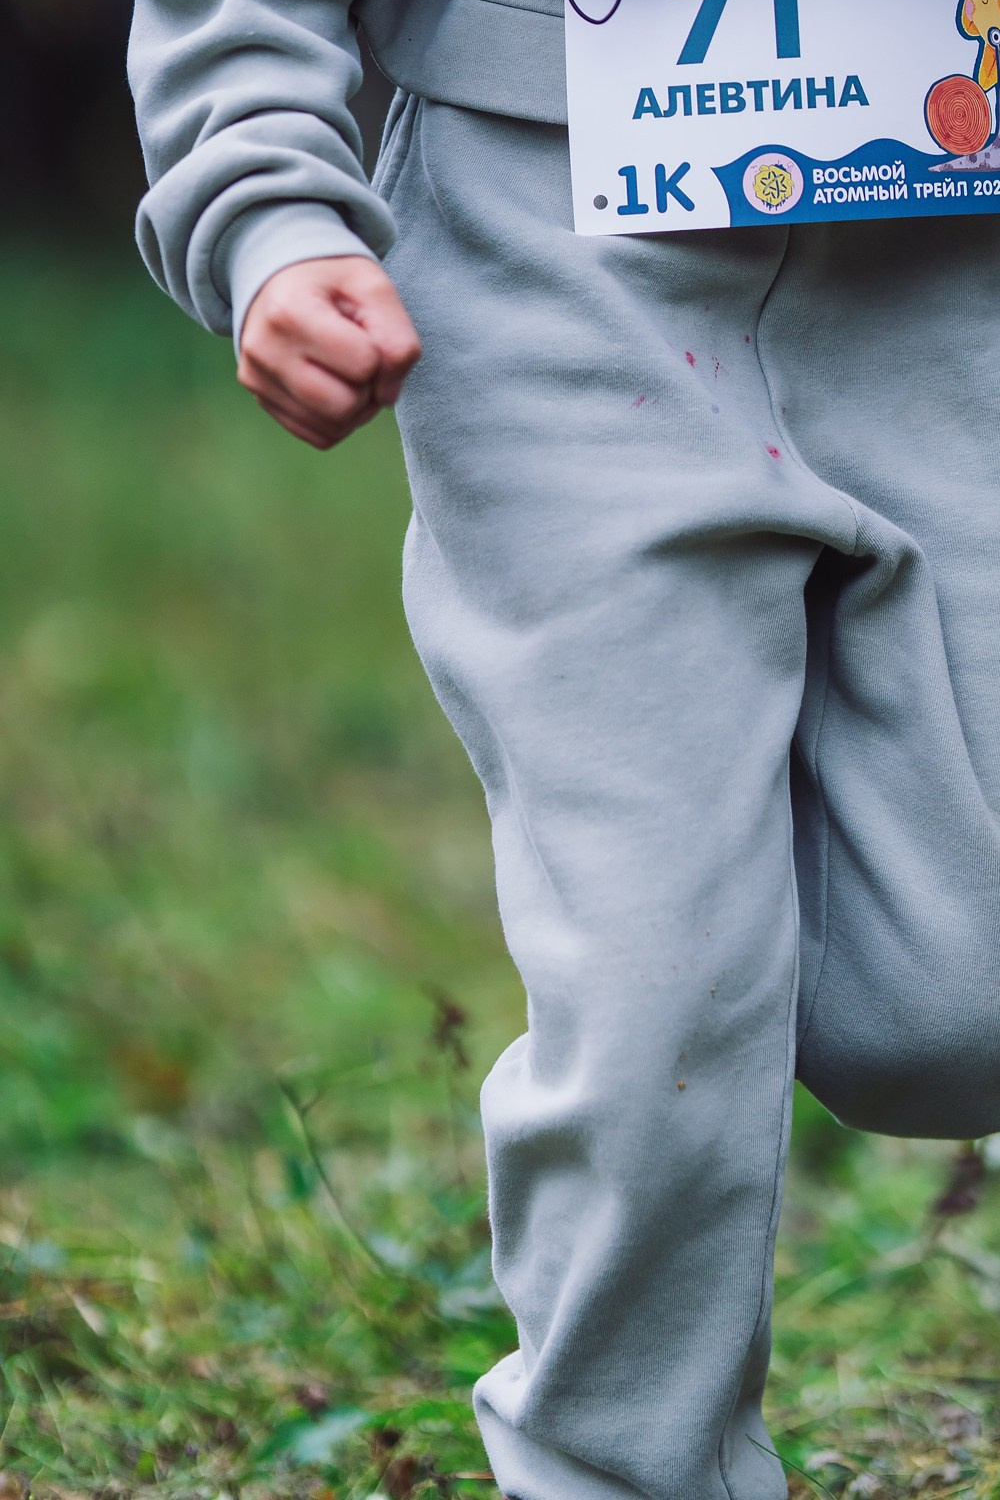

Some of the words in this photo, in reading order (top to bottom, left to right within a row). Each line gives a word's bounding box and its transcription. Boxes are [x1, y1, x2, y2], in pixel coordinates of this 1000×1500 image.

[632, 75, 869, 119] АЛЕВТИНА
[813, 161, 905, 184] ВОСЬМОЙ
[813, 181, 908, 204] АТОМНЫЙ
[913, 178, 968, 199] ТРЕЙЛ
